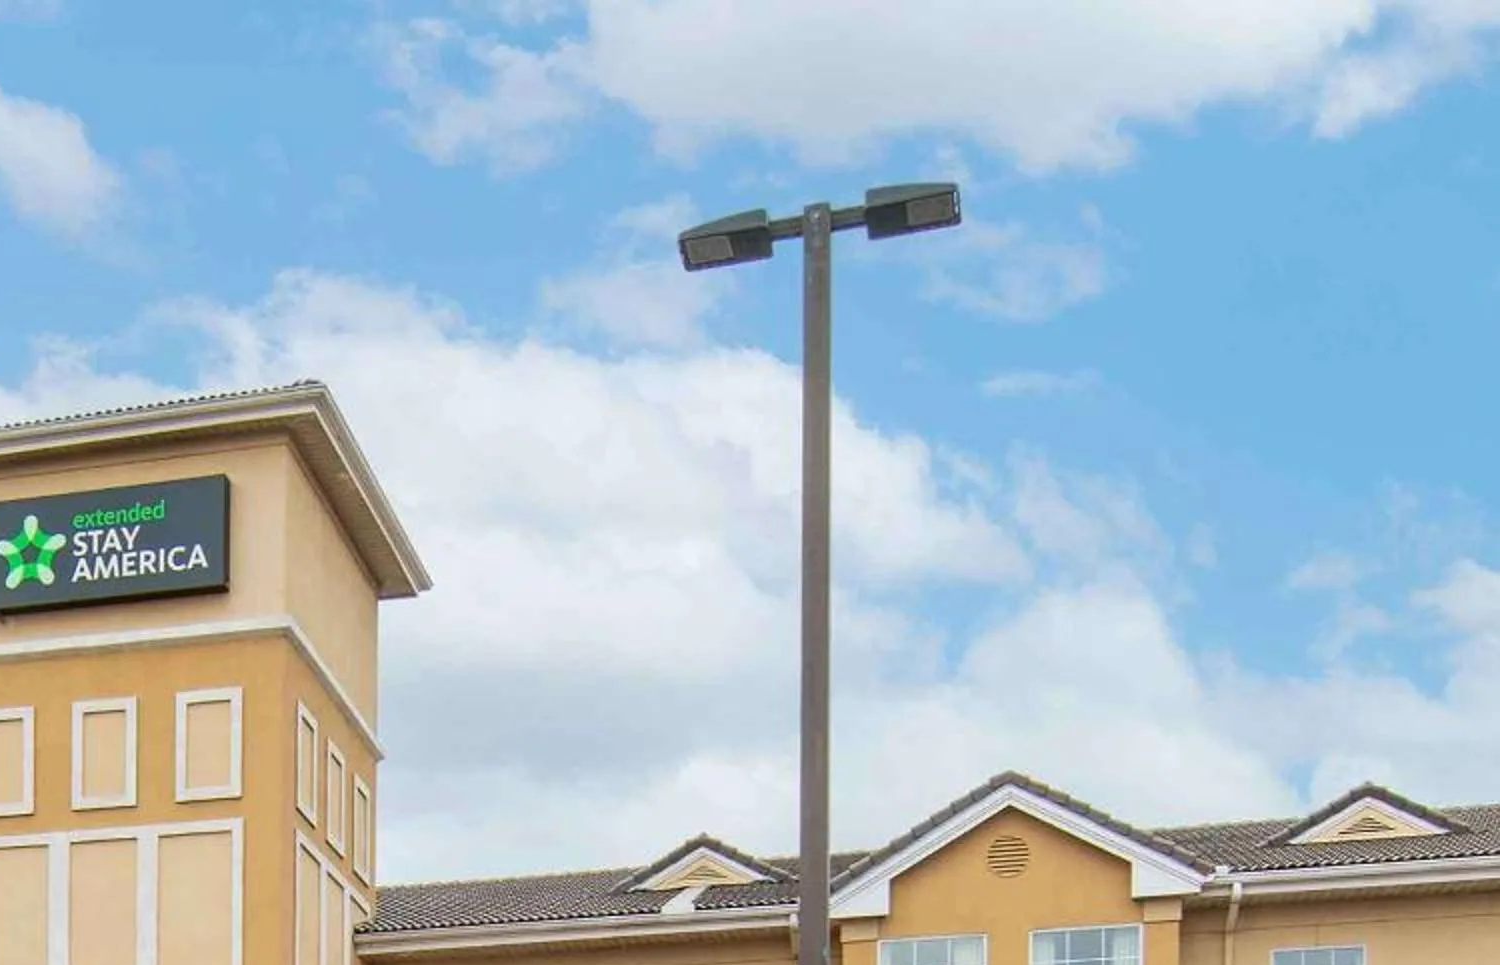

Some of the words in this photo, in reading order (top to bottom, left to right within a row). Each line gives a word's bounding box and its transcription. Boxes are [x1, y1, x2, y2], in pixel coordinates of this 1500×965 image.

[73, 500, 165, 528] extended
[73, 525, 140, 556] STAY
[71, 544, 208, 583] AMERICA
